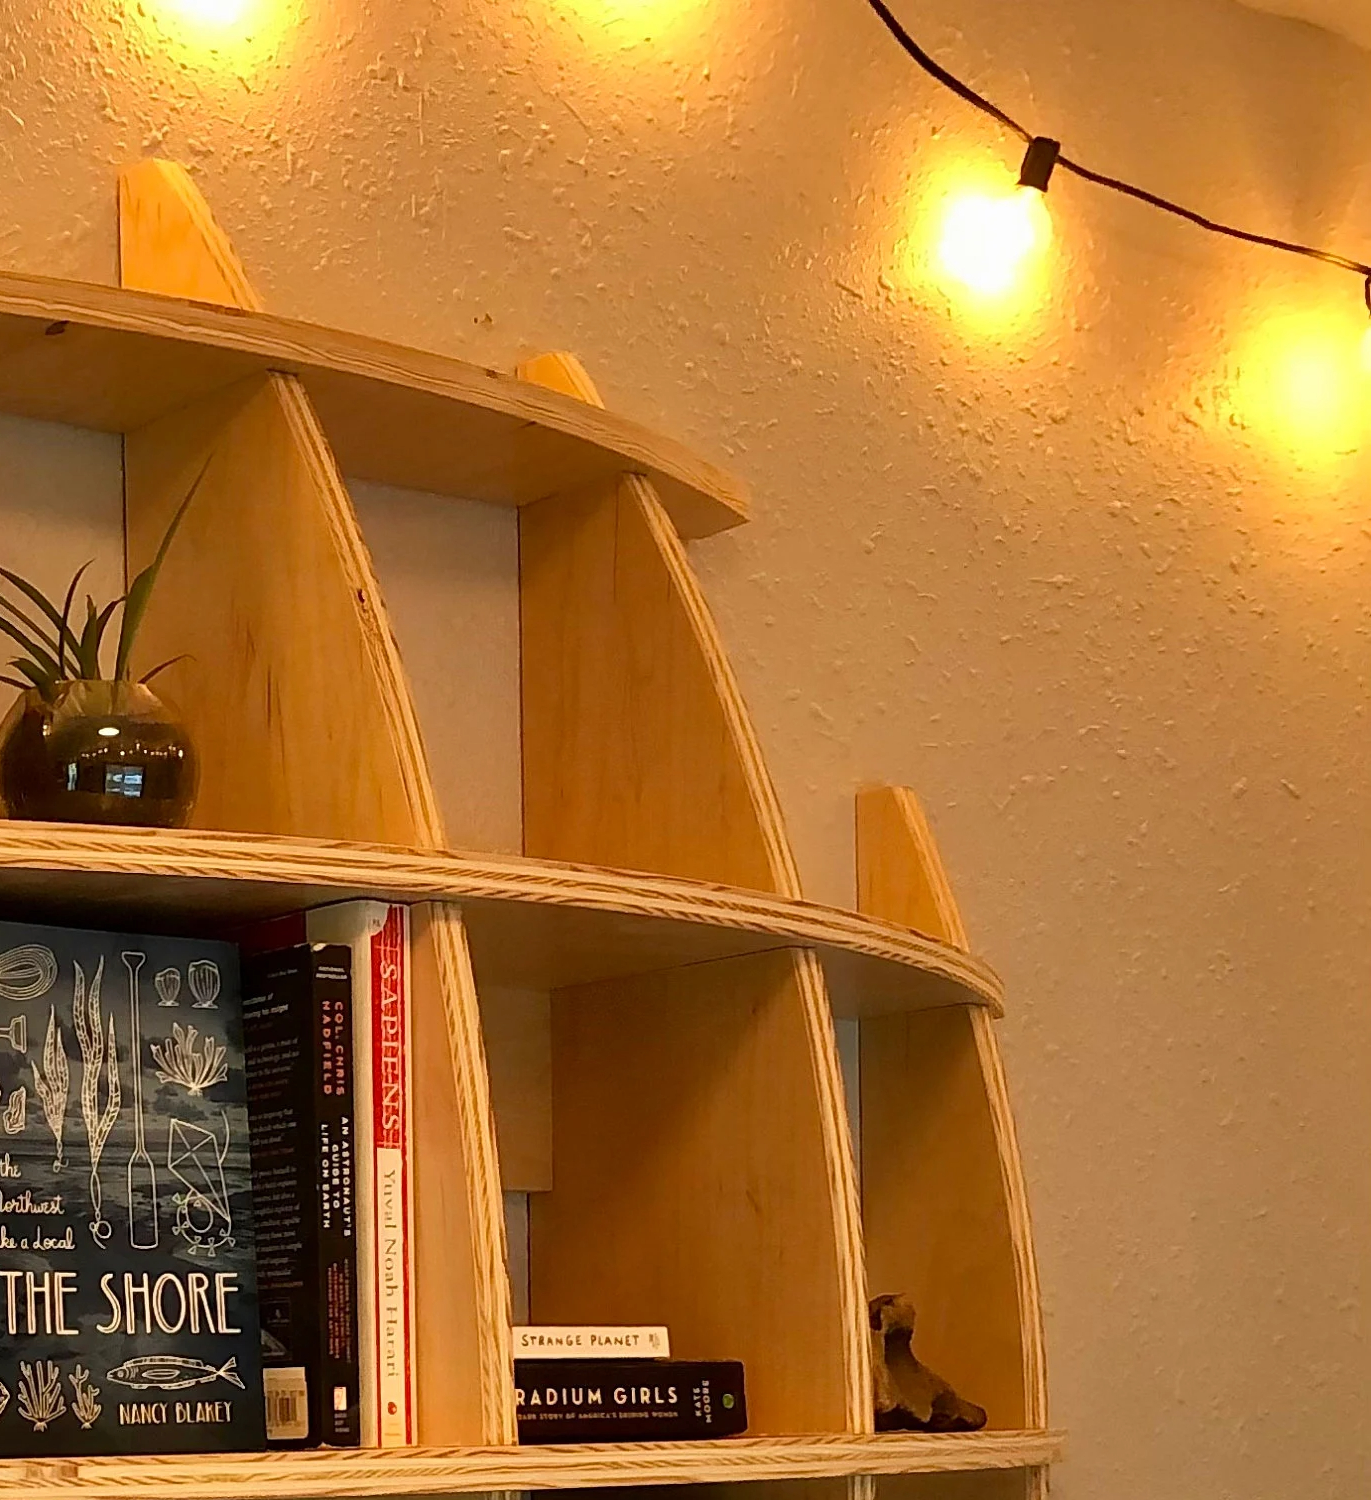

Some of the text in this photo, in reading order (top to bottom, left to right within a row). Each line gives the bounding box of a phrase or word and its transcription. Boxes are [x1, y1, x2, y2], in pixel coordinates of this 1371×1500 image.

[322, 1000, 332, 1095] HADFIELD
[334, 1001, 345, 1096] COL. CHRIS
[379, 962, 400, 1130] SAPIENS
[321, 1124, 331, 1228] LIFE ON EARTH
[331, 1144, 340, 1209] GUIDE TO
[341, 1116, 352, 1237] AN ASTRONAUT'S
[20, 1237, 29, 1250] a
[32, 1224, 76, 1250] Local
[96, 1272, 241, 1335] SHORE
[384, 1169, 399, 1377] Yuval Noah Harari
[521, 1334, 582, 1347] STRANGE
[590, 1334, 640, 1347] PLANET
[119, 1401, 232, 1425] NANCY BLAKEY
[515, 1386, 678, 1406] RADIUM GIRLS
[693, 1387, 702, 1417] KATE
[702, 1380, 712, 1423] MOORE
